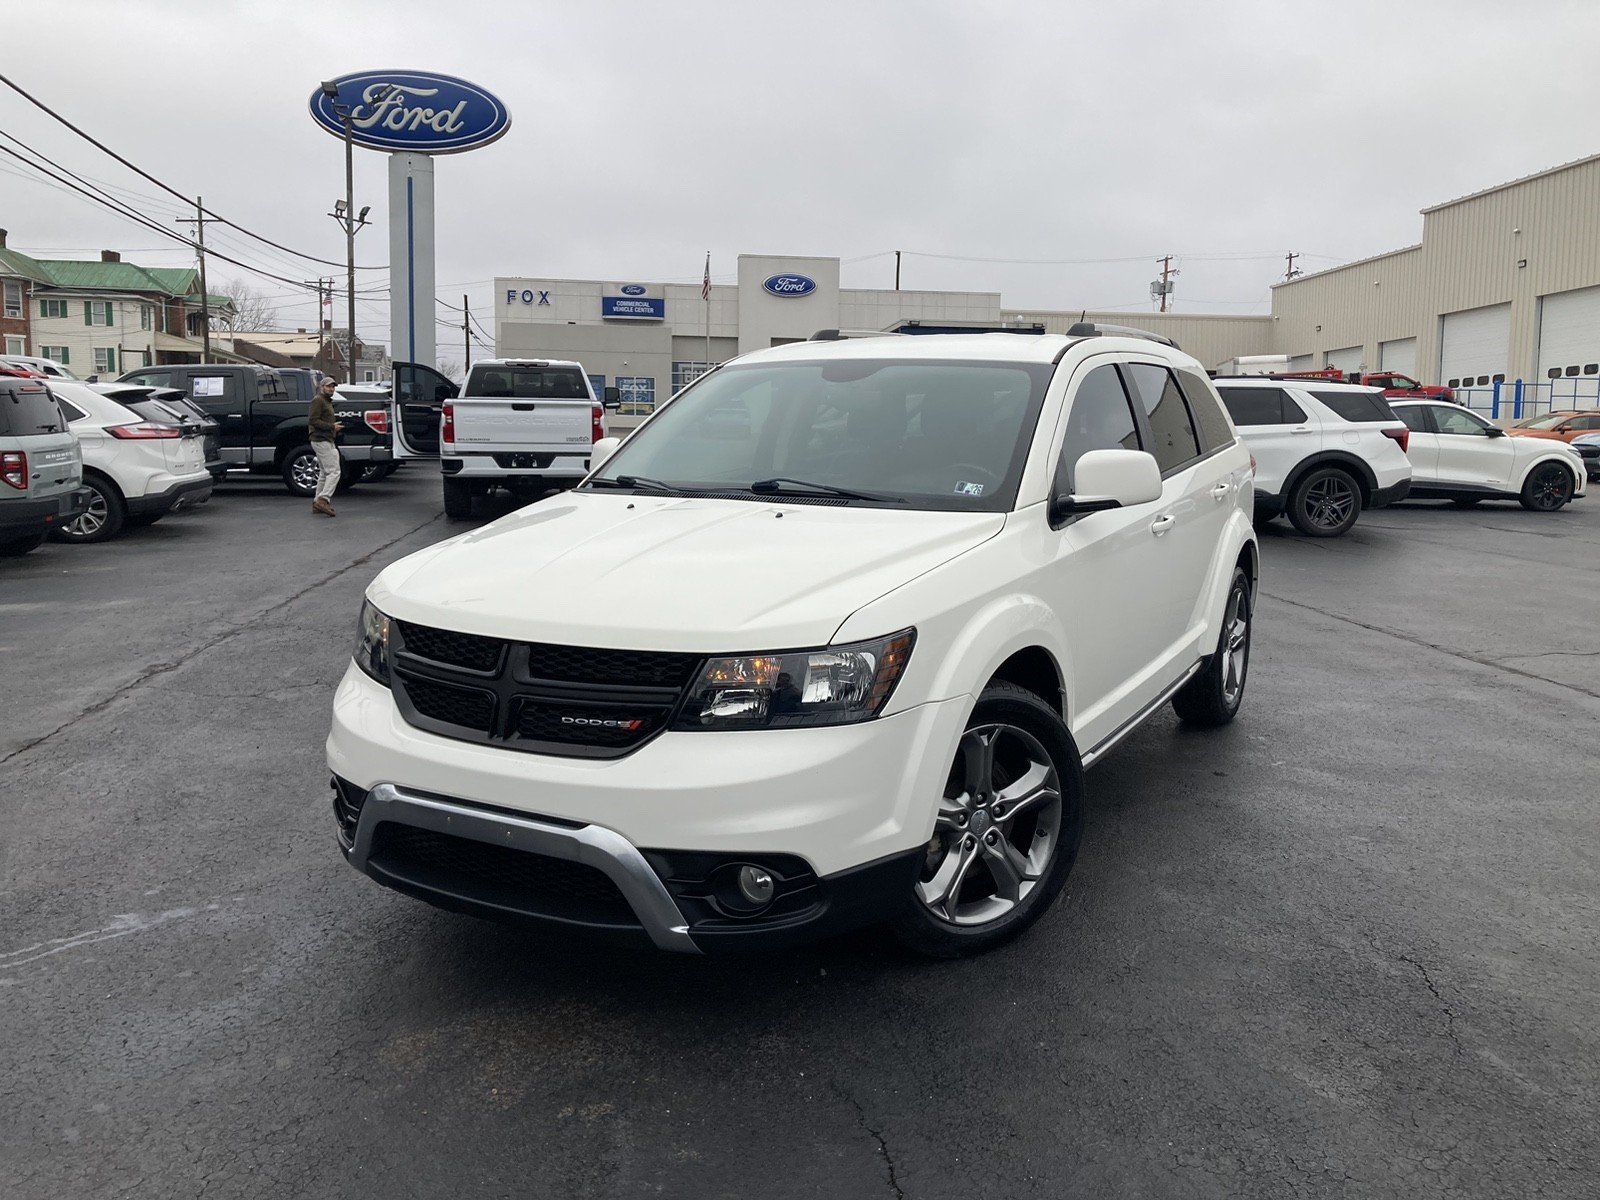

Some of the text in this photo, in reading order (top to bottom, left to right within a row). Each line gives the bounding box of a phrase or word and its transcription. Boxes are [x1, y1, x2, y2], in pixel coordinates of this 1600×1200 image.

[351, 83, 468, 133] Ford
[625, 286, 642, 294] Ford
[774, 277, 806, 292] Ford
[506, 289, 550, 305] FOX
[616, 300, 650, 308] COMMERCIAL
[634, 306, 655, 314] CENTER
[622, 384, 648, 394] FOX
[462, 415, 584, 427] CHEVROLET
[561, 716, 631, 729] DODGE
